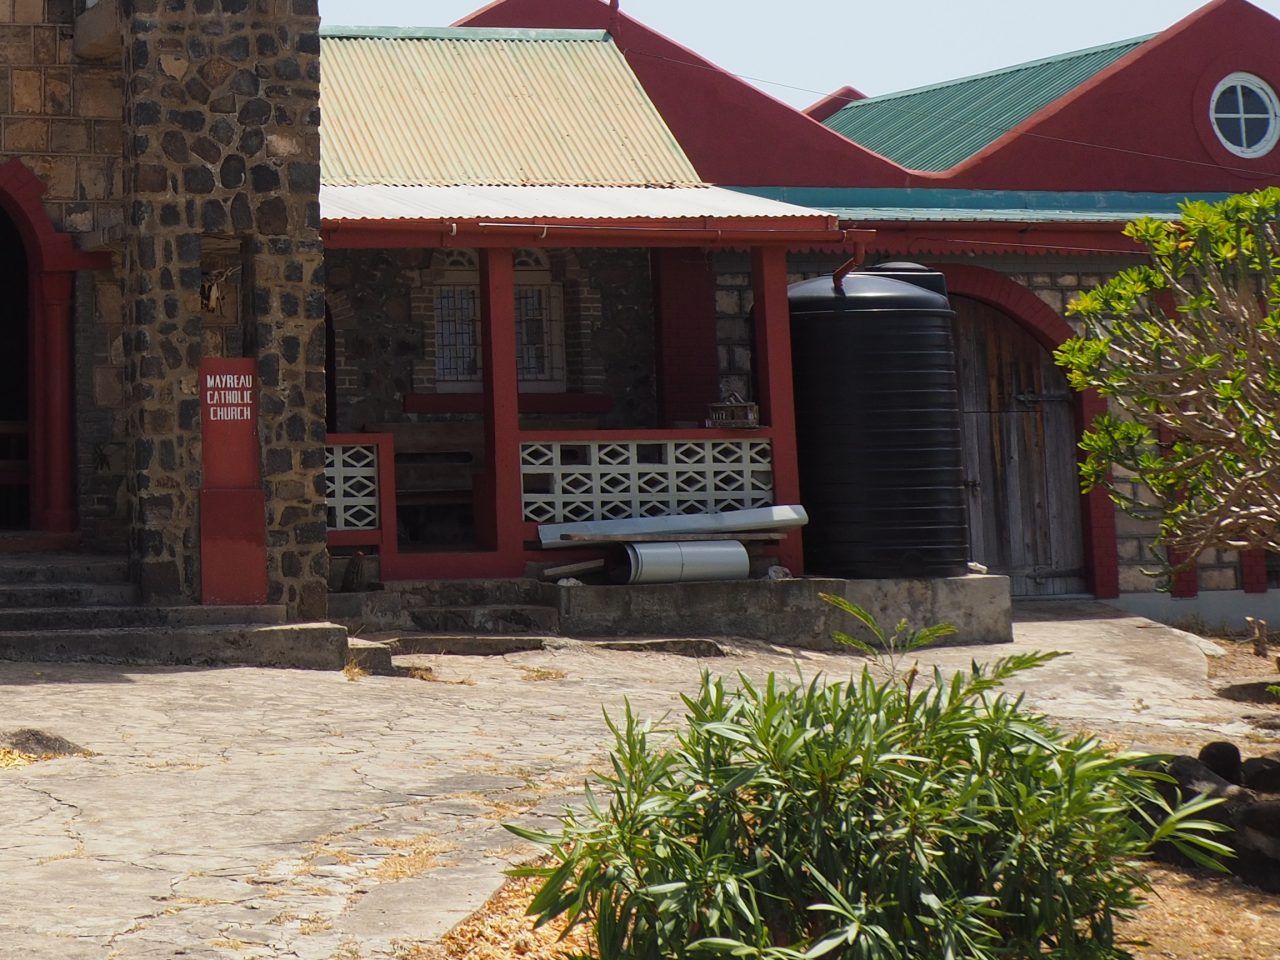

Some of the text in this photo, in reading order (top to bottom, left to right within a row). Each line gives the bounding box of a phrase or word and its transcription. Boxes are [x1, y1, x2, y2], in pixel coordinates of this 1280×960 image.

[206, 375, 252, 388] MAYREAU
[206, 391, 252, 404] CATHOLIC
[210, 407, 251, 420] CHURCH
